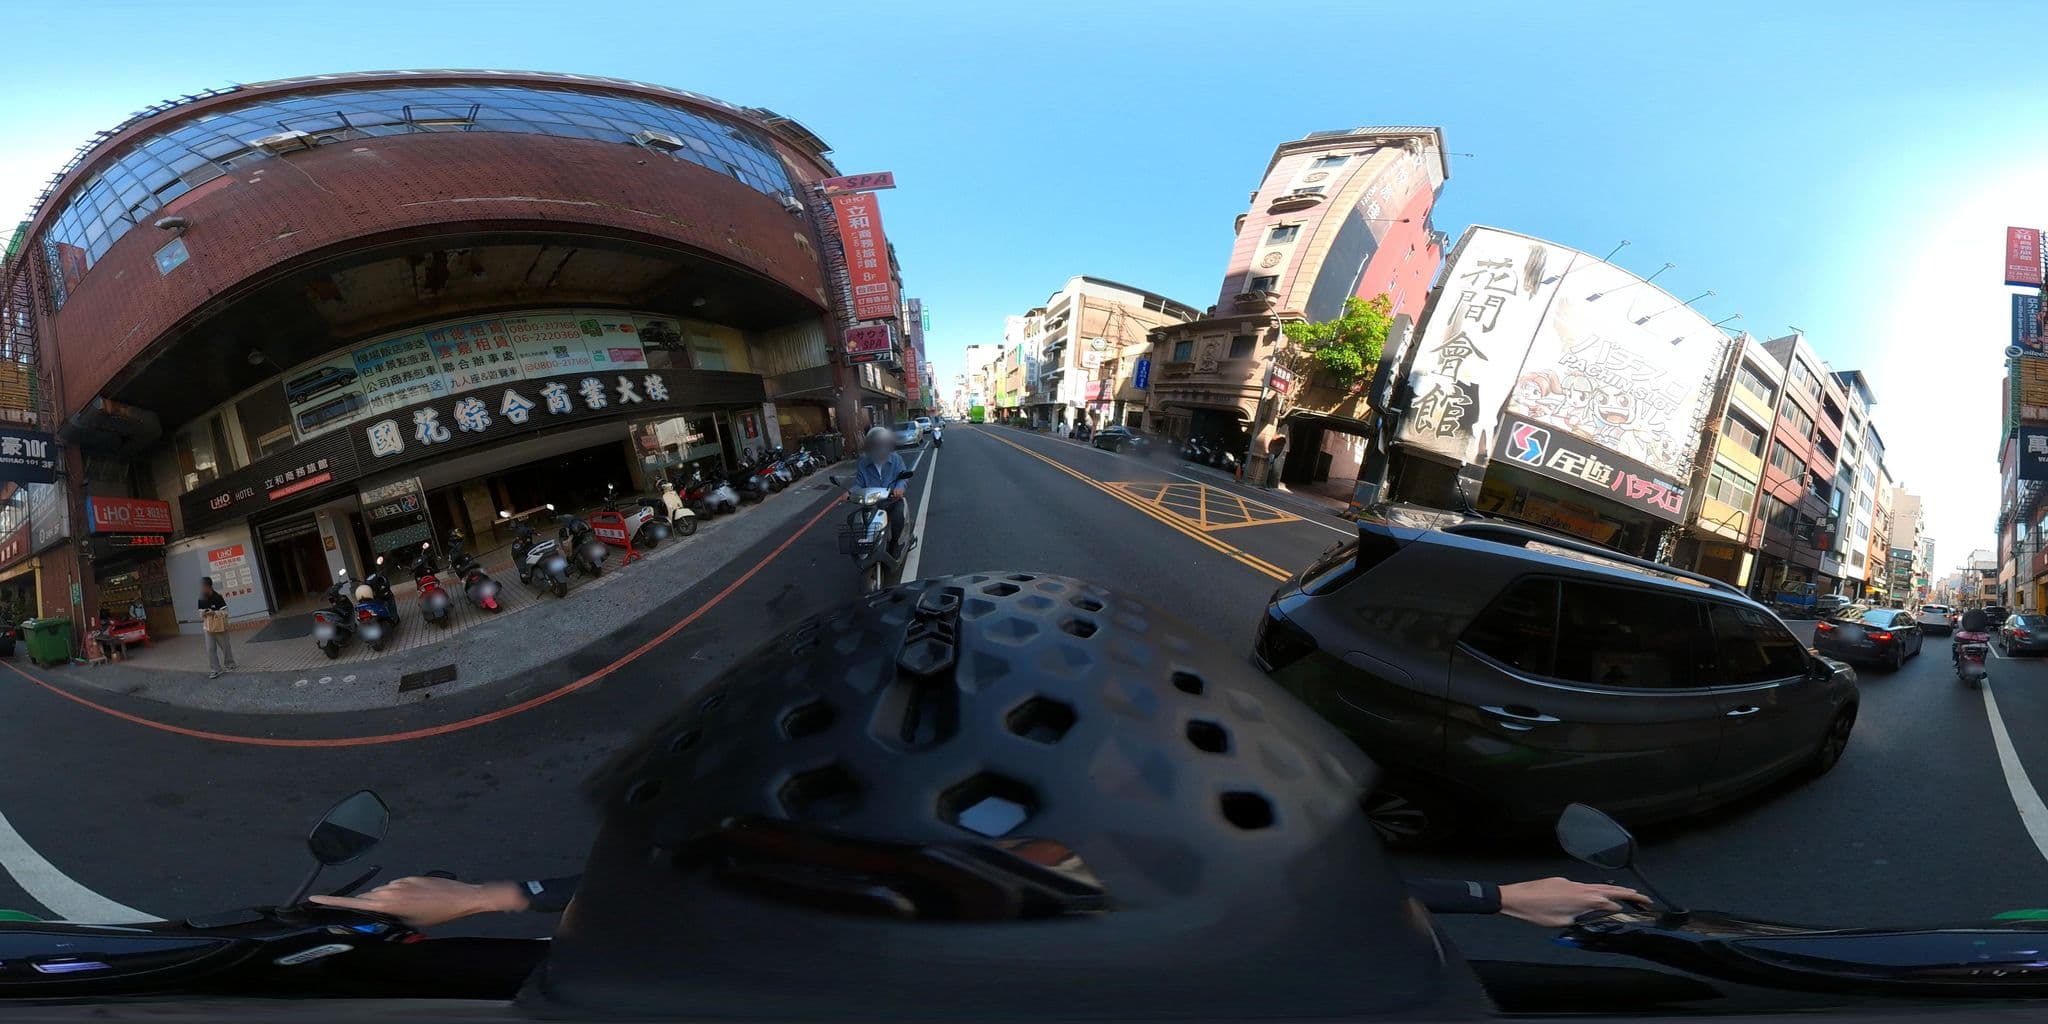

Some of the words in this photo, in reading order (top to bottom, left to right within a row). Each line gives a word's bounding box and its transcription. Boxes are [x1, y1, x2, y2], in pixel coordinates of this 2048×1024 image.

[847, 175, 888, 188] SPA
[847, 206, 870, 228] 立和
[509, 321, 576, 333] 0800-217168
[513, 331, 580, 343] 06-2220369
[863, 339, 882, 349] SPA
[1411, 257, 1518, 439] 花間會館
[442, 351, 515, 372] 聯合辦事處
[367, 365, 437, 393] 公司商務包車
[1558, 352, 1633, 393] PACHIN
[1634, 387, 1678, 415] SLOT
[366, 374, 670, 458] 國花綜合商業大樓
[265, 459, 329, 489] 立和商務旅館
[210, 494, 230, 509] LiHO
[235, 488, 255, 501] HOTEL
[1611, 470, 1684, 515] パチスロ
[93, 505, 130, 524] LiHO
